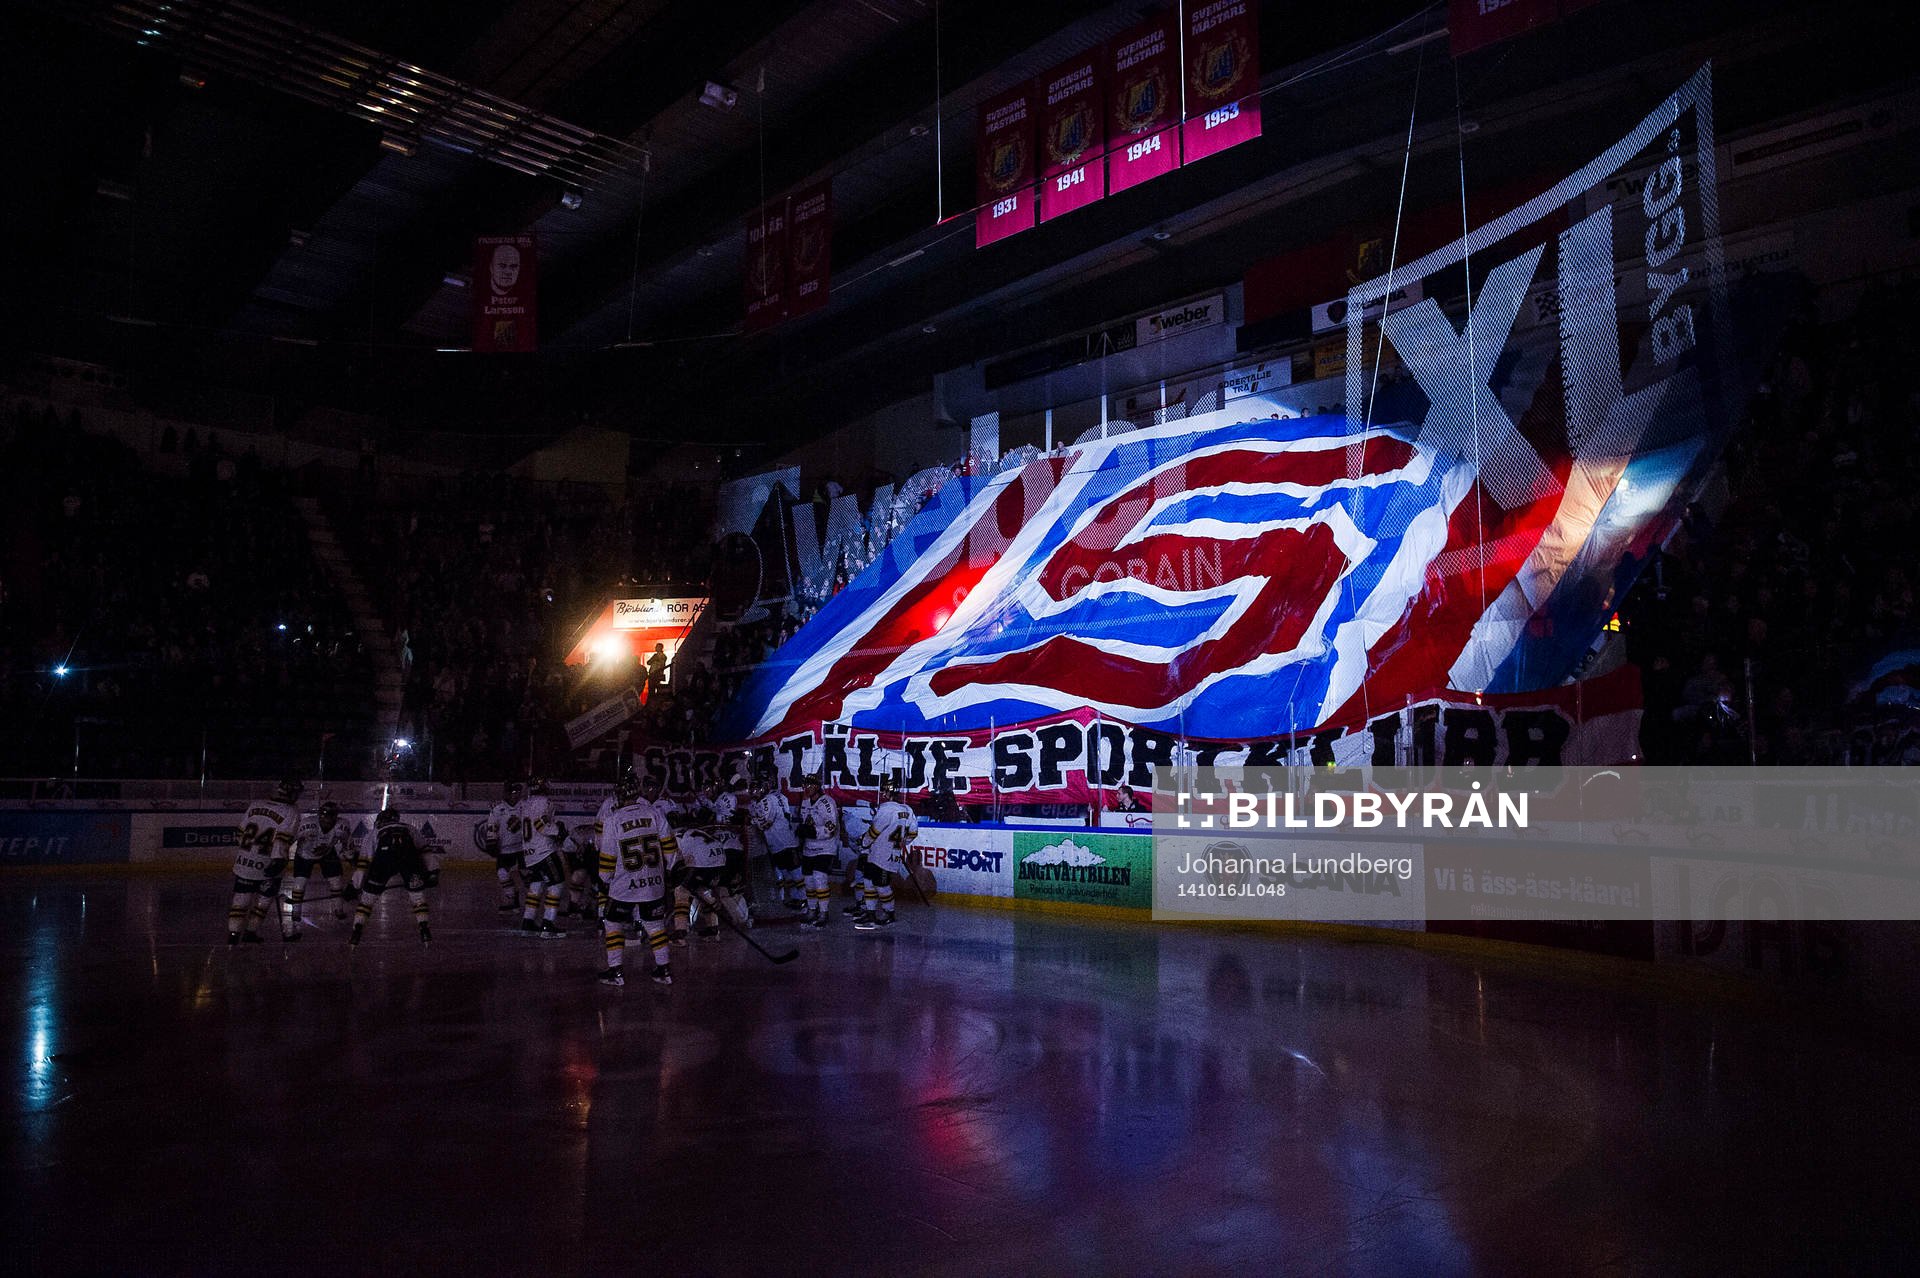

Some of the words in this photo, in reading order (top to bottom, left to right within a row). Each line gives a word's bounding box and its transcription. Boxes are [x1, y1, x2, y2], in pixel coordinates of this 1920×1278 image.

[1204, 101, 1240, 130] 1953
[1127, 135, 1161, 162] 1944
[1056, 168, 1085, 192] 1941
[993, 196, 1018, 218] 1931
[1643, 155, 1696, 365] BYGG
[484, 306, 525, 315] Larsson
[491, 296, 519, 305] Peter
[1161, 305, 1211, 329] weber
[1378, 204, 1702, 511] XL
[667, 601, 689, 613] RÖR
[241, 822, 277, 856] 24
[619, 834, 660, 872] 55
[1433, 867, 1456, 892] Vi
